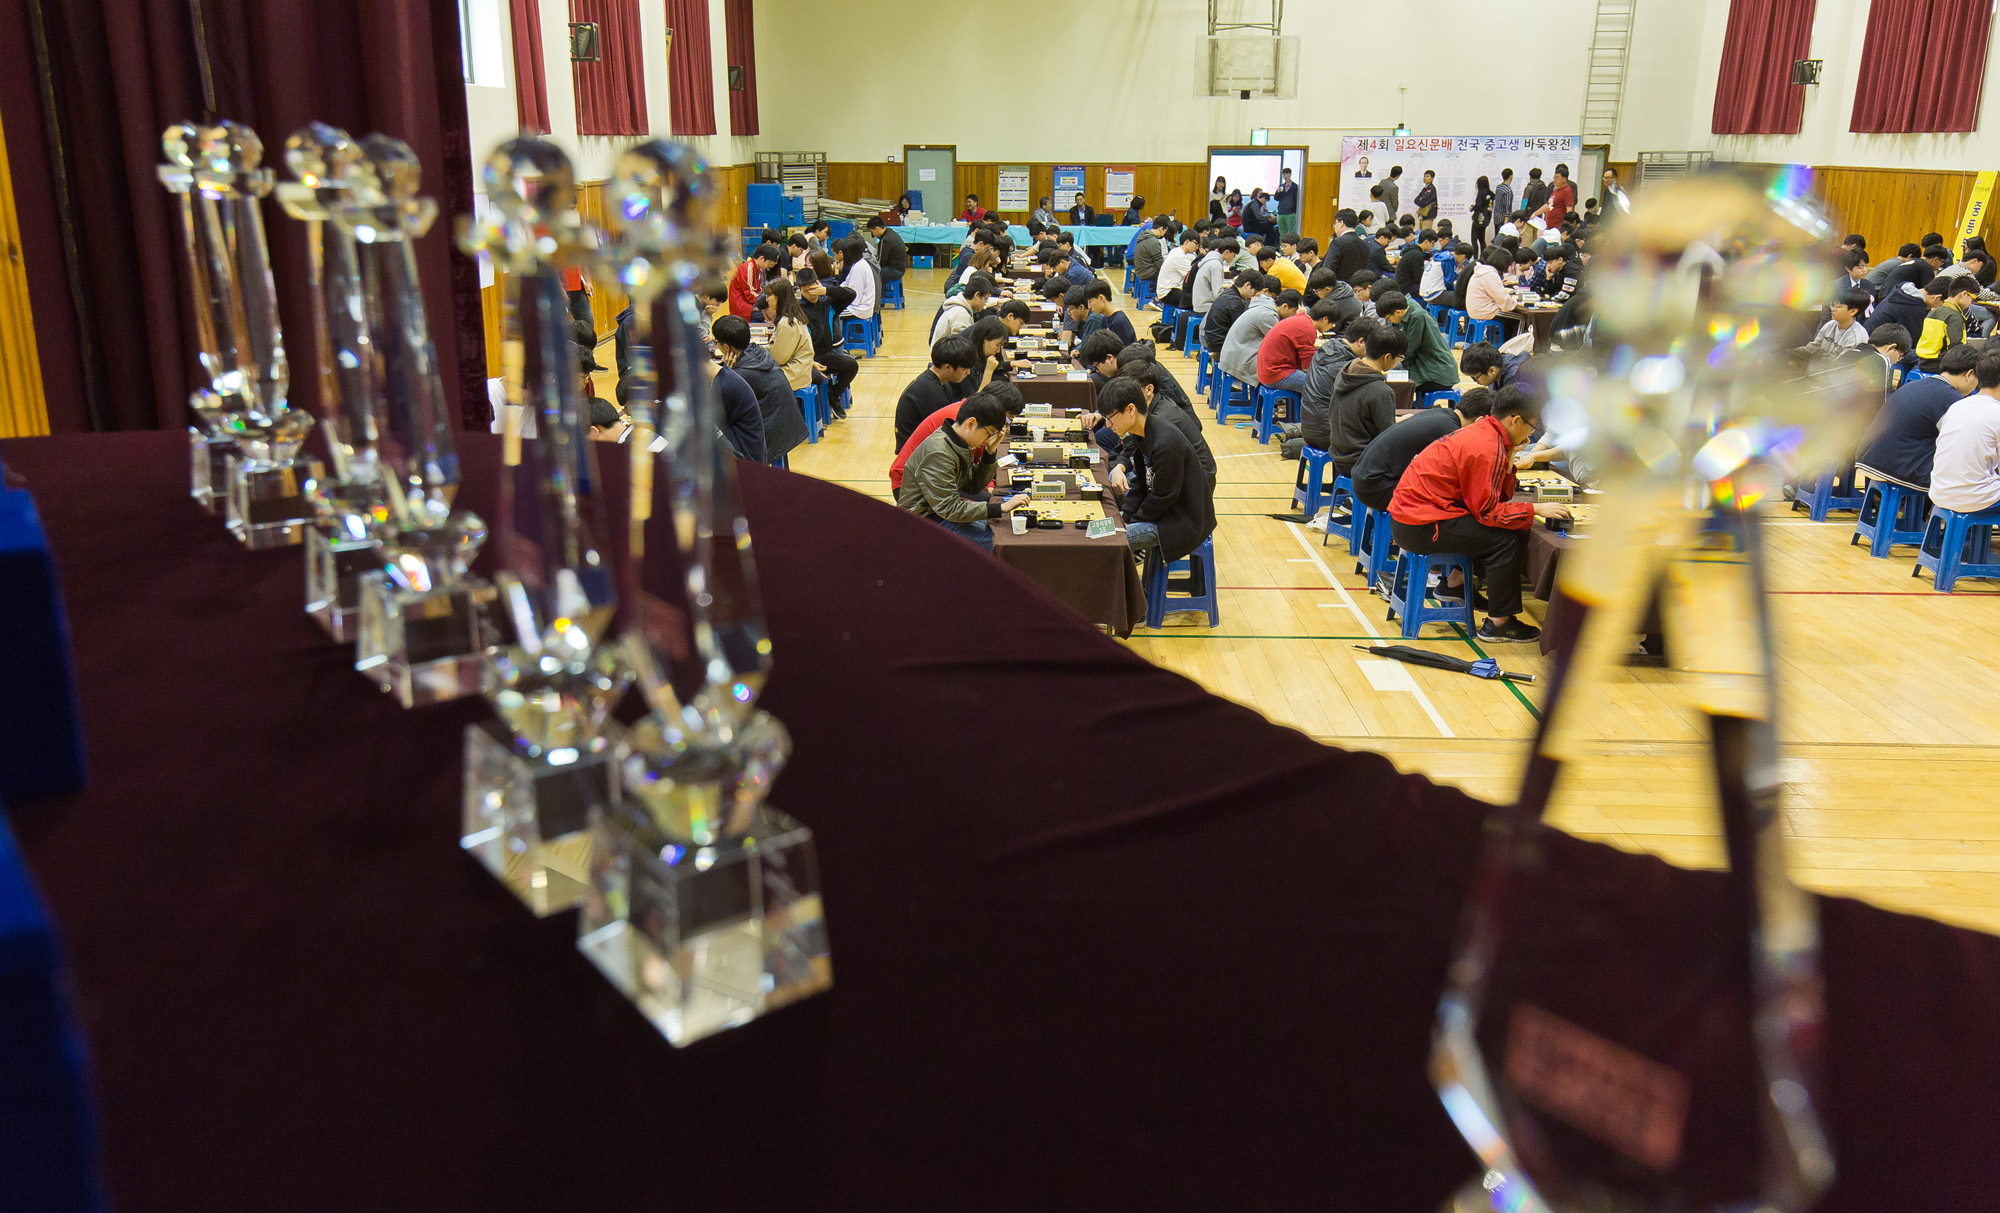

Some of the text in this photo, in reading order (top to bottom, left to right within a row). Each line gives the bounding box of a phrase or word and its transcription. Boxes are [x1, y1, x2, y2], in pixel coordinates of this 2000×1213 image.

[1357, 138, 1571, 151] 제4회 일요신문배 전국 중고생 바둑왕전
